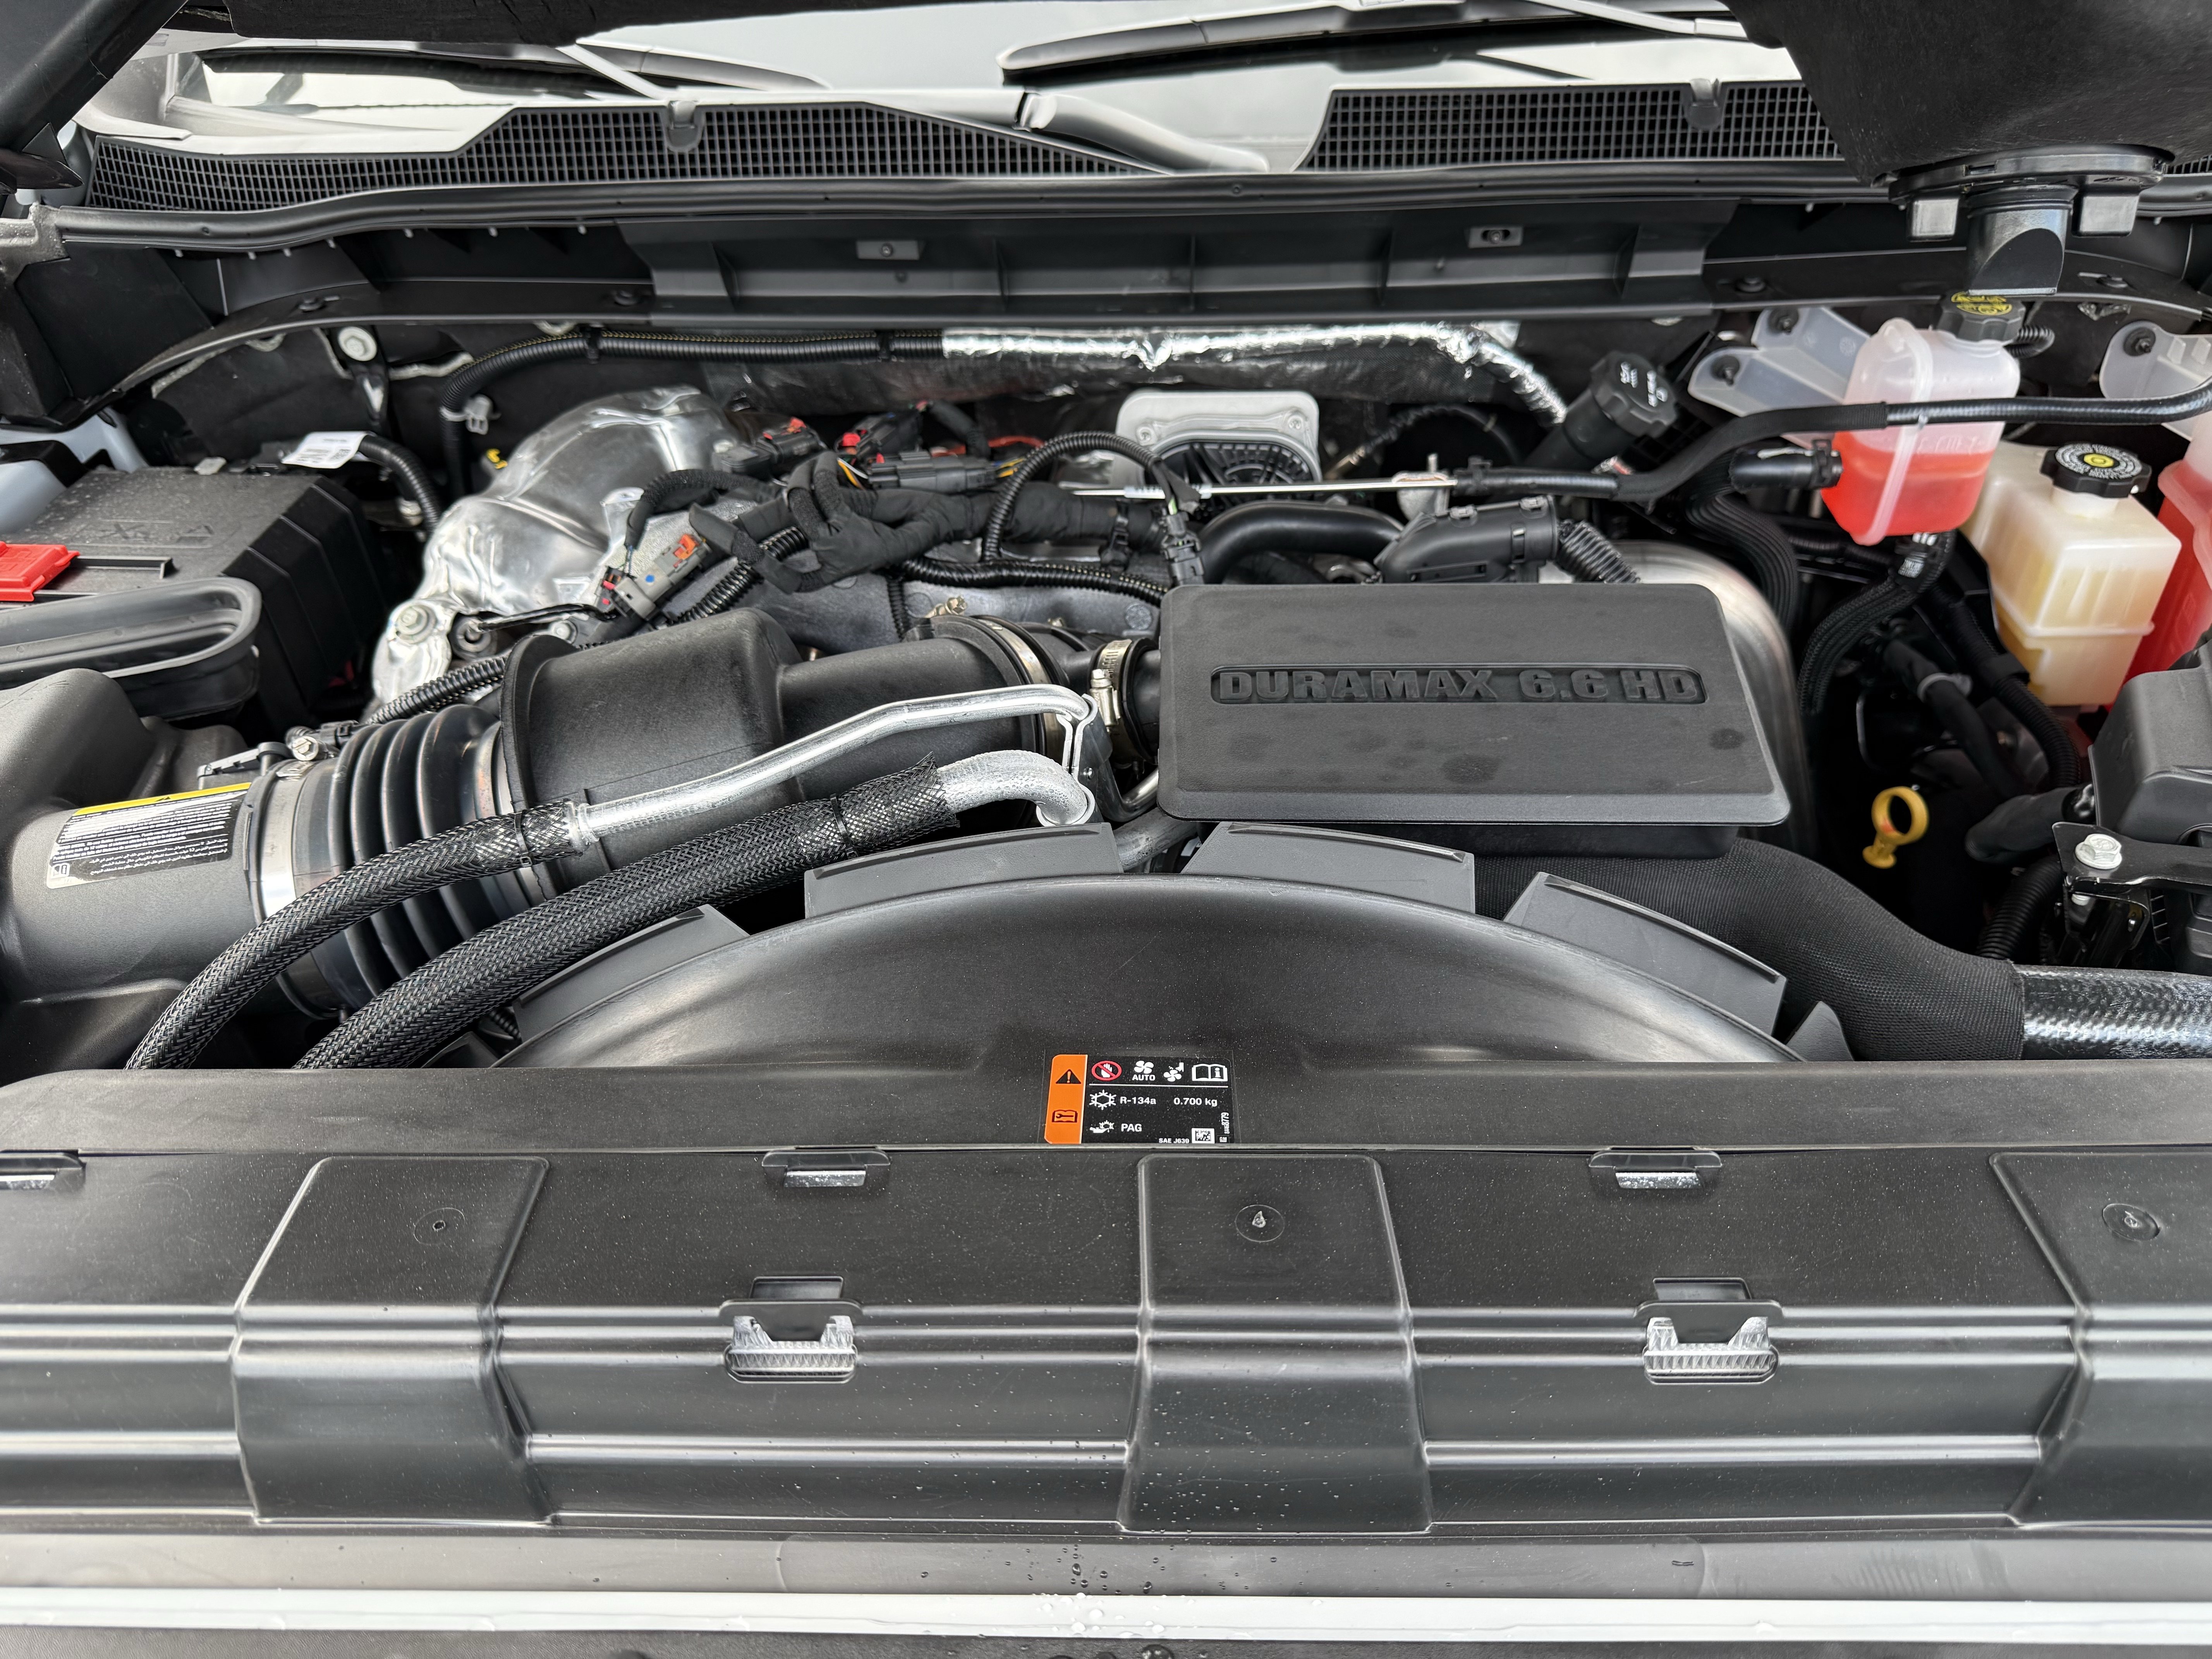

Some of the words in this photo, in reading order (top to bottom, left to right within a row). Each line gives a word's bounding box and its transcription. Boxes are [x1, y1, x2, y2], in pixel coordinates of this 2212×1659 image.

[1219, 670, 1498, 700] DURAMAX
[1519, 670, 1608, 699] 6.6
[1620, 670, 1697, 699] HD
[1120, 1096, 1156, 1104] R-134a
[1205, 1097, 1218, 1107] kg
[1121, 1123, 1142, 1132] PAG
